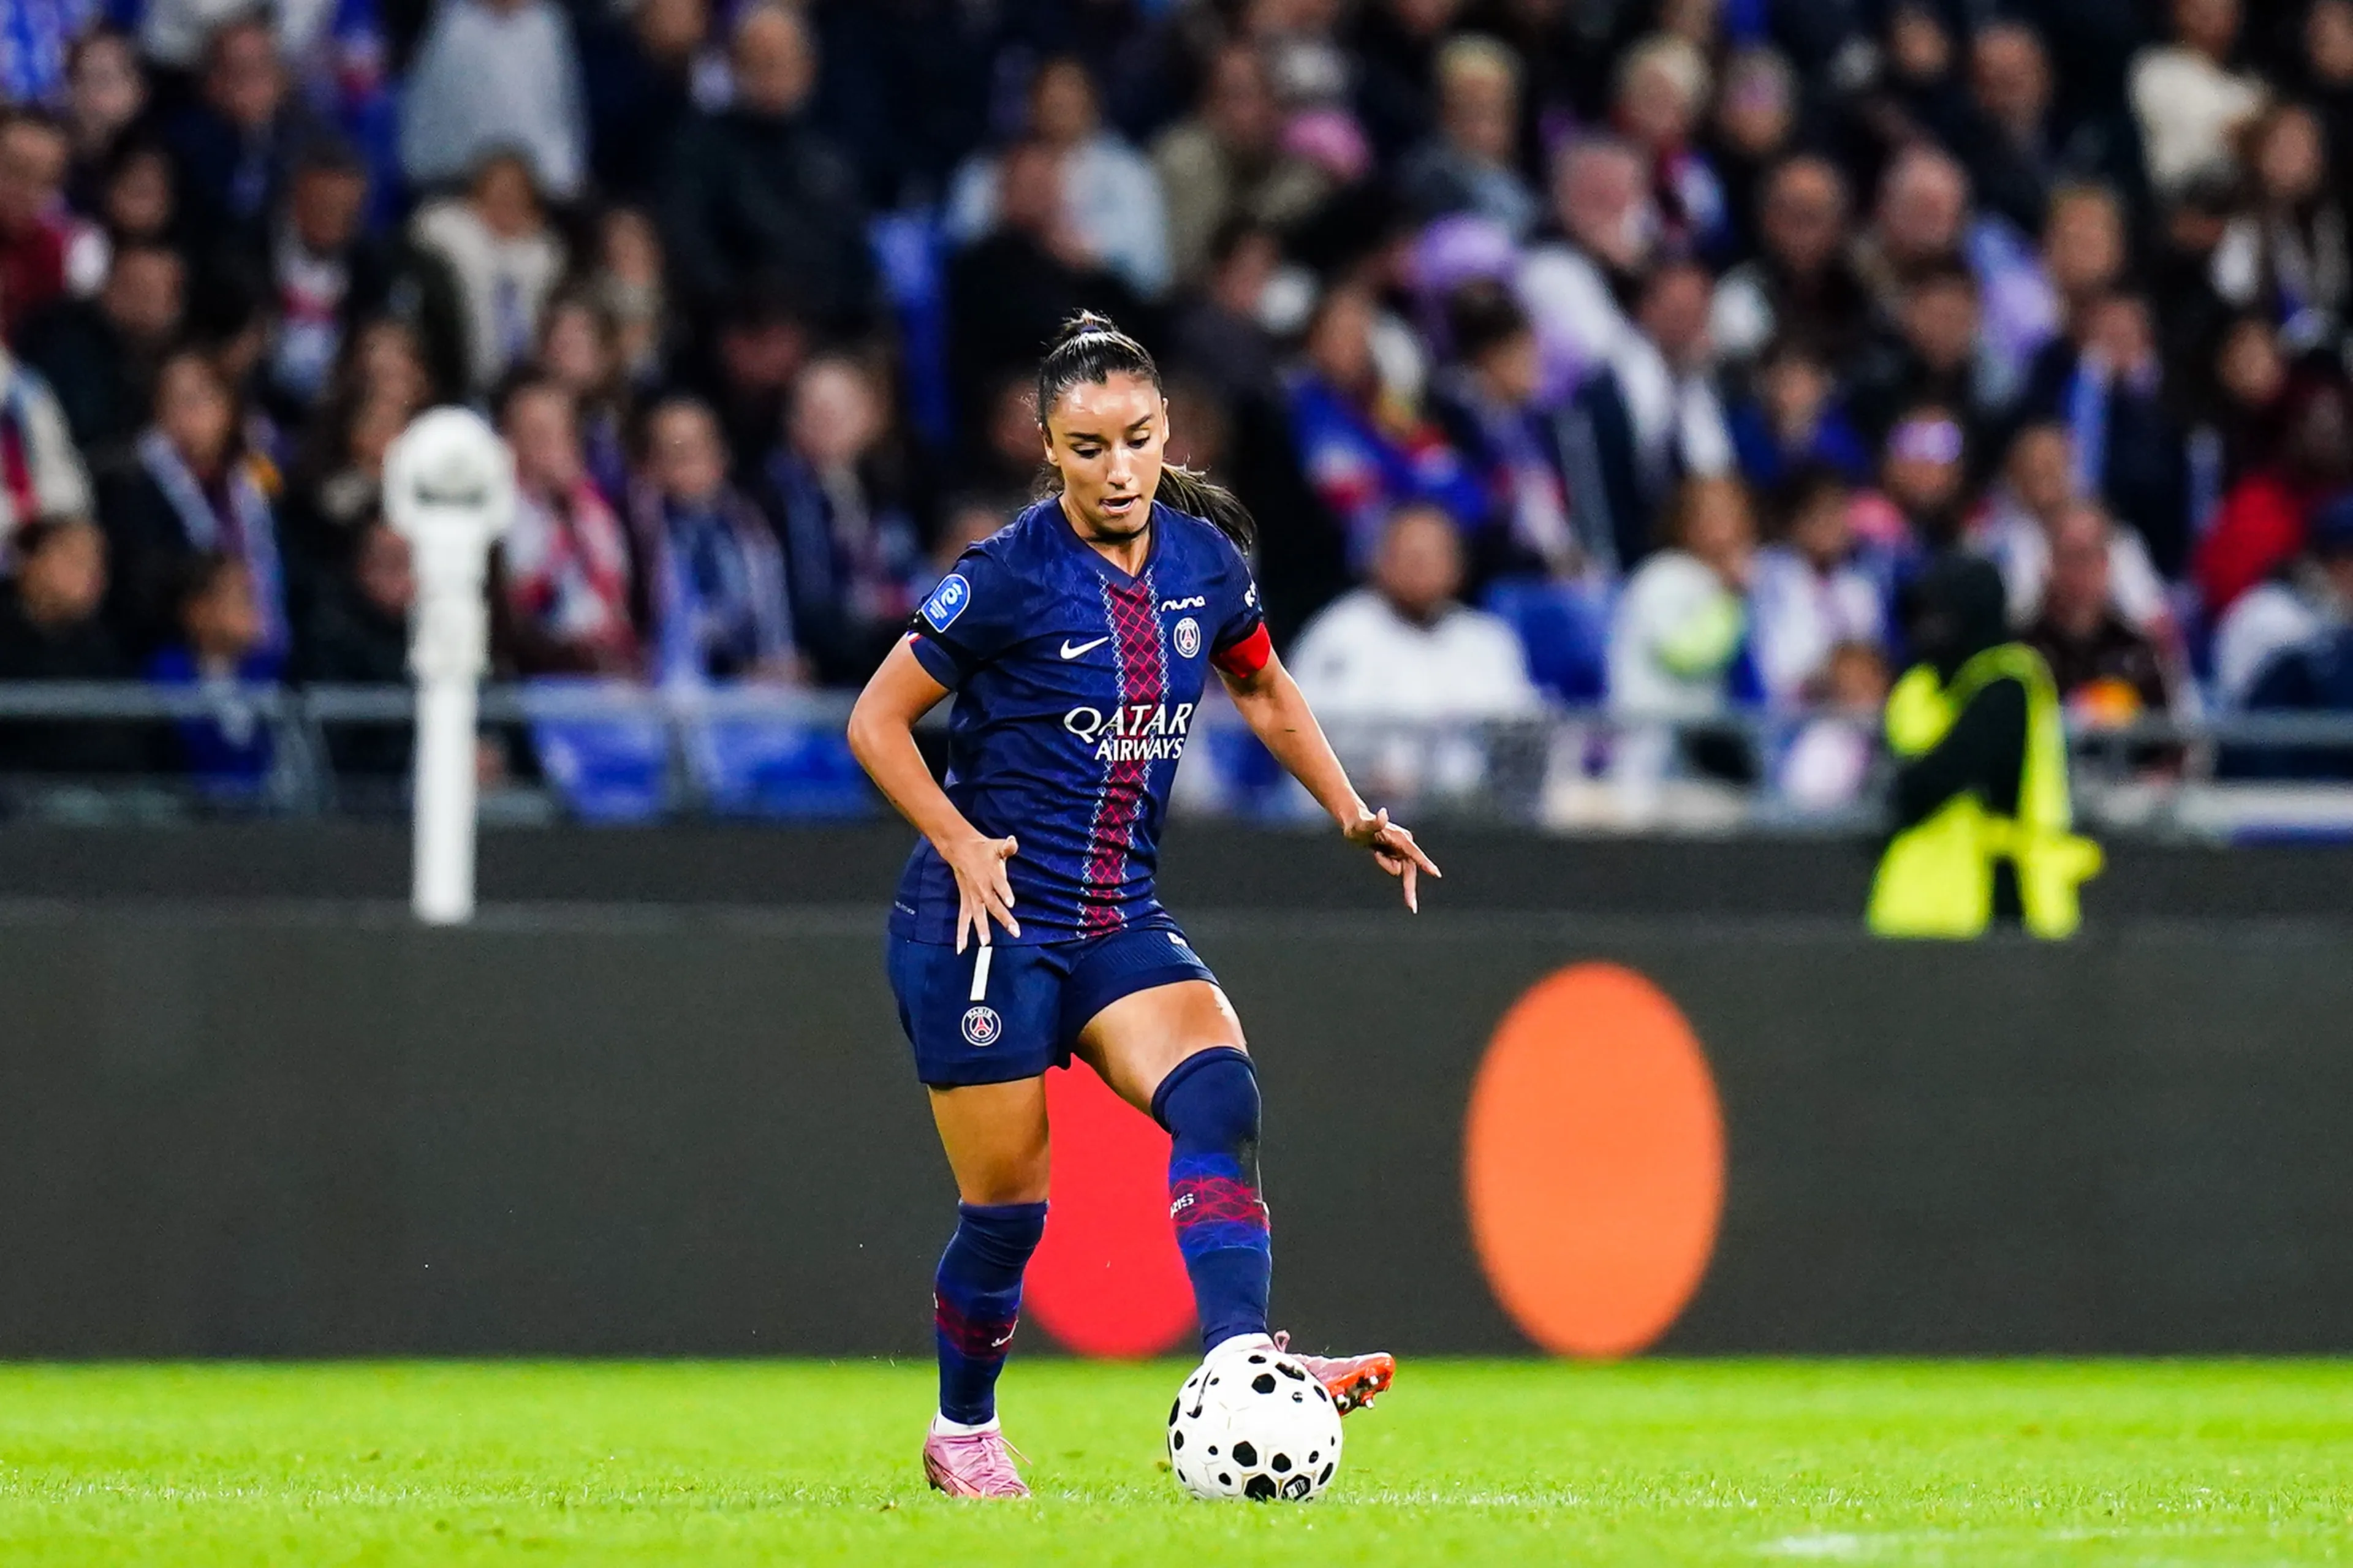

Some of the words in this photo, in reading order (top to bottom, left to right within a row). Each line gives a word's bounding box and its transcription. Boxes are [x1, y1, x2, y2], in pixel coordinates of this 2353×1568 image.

[1161, 596, 1205, 612] nuna
[1064, 703, 1192, 743] QATAR
[1094, 738, 1184, 760] AIRWAYS
